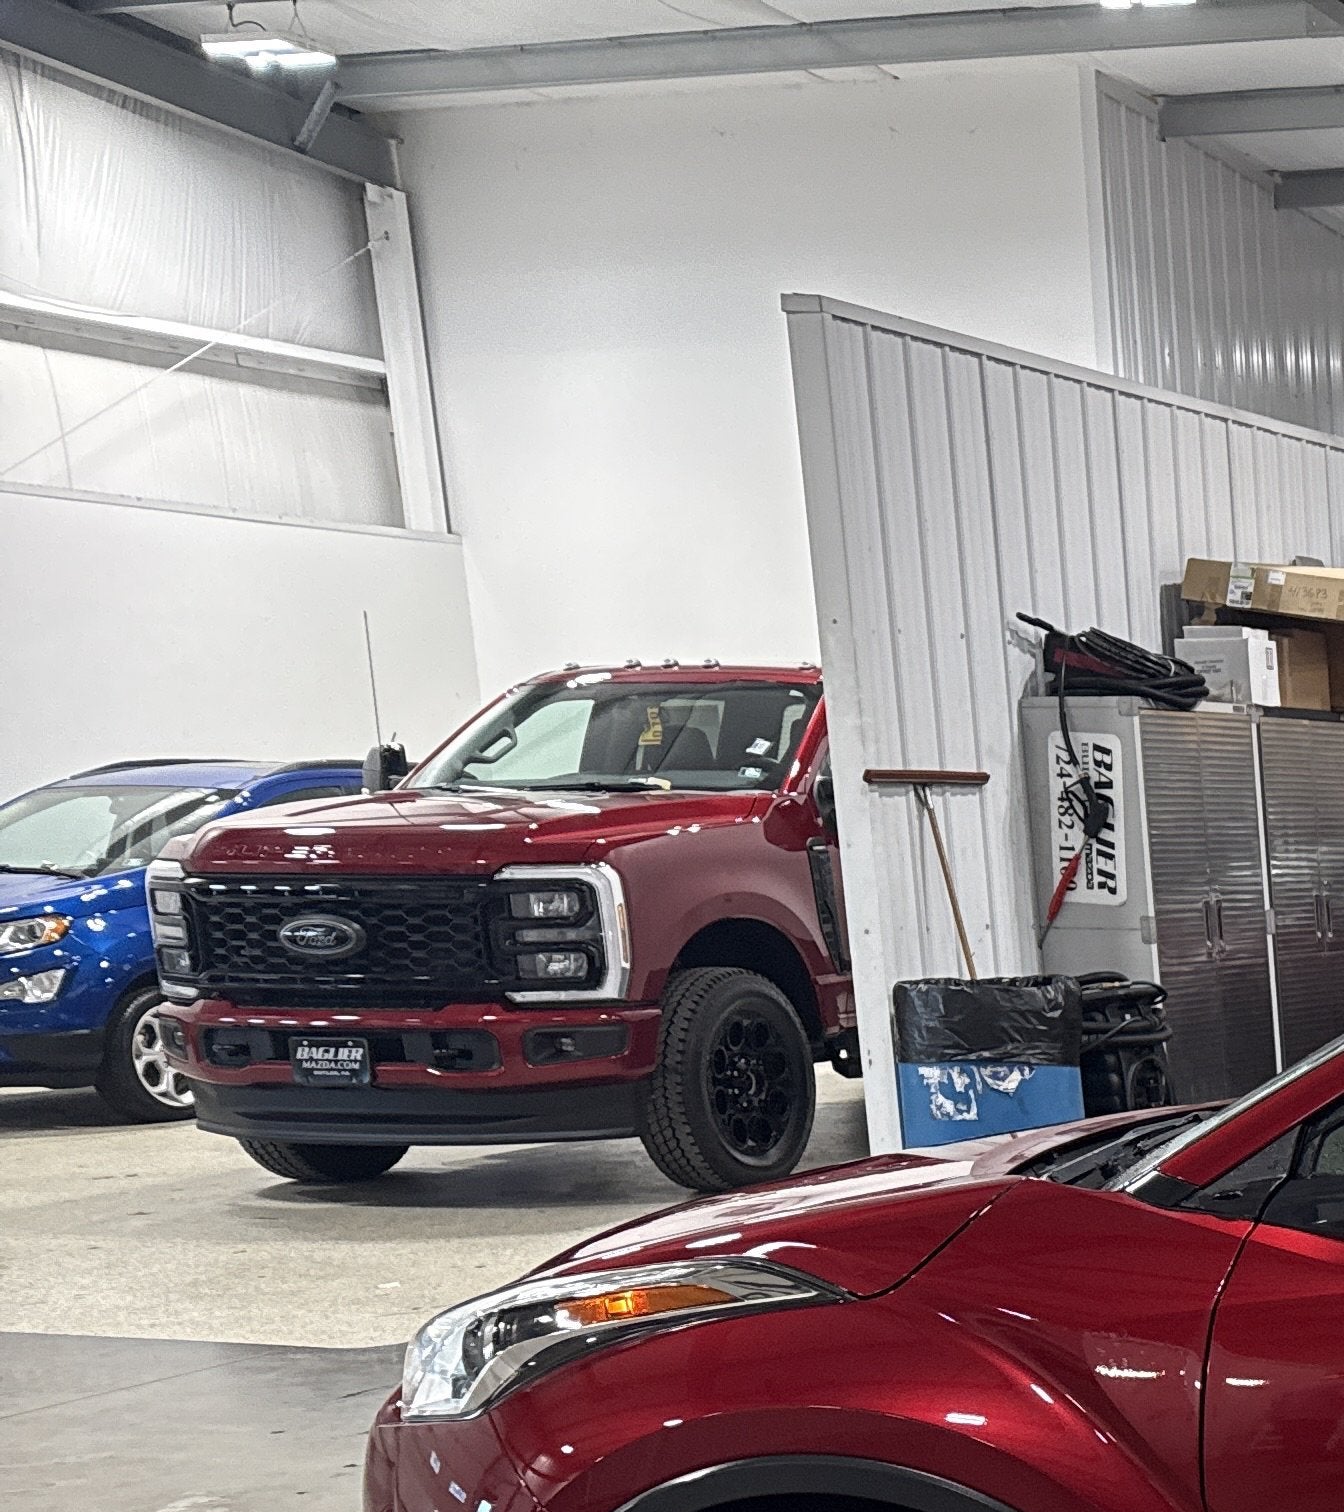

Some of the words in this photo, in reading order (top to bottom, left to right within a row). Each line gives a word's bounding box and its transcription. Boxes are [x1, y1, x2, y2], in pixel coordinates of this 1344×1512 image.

[296, 926, 337, 946] Ford
[296, 1046, 364, 1060] BAGLIER
[302, 1060, 360, 1069] MAZDA.COM
